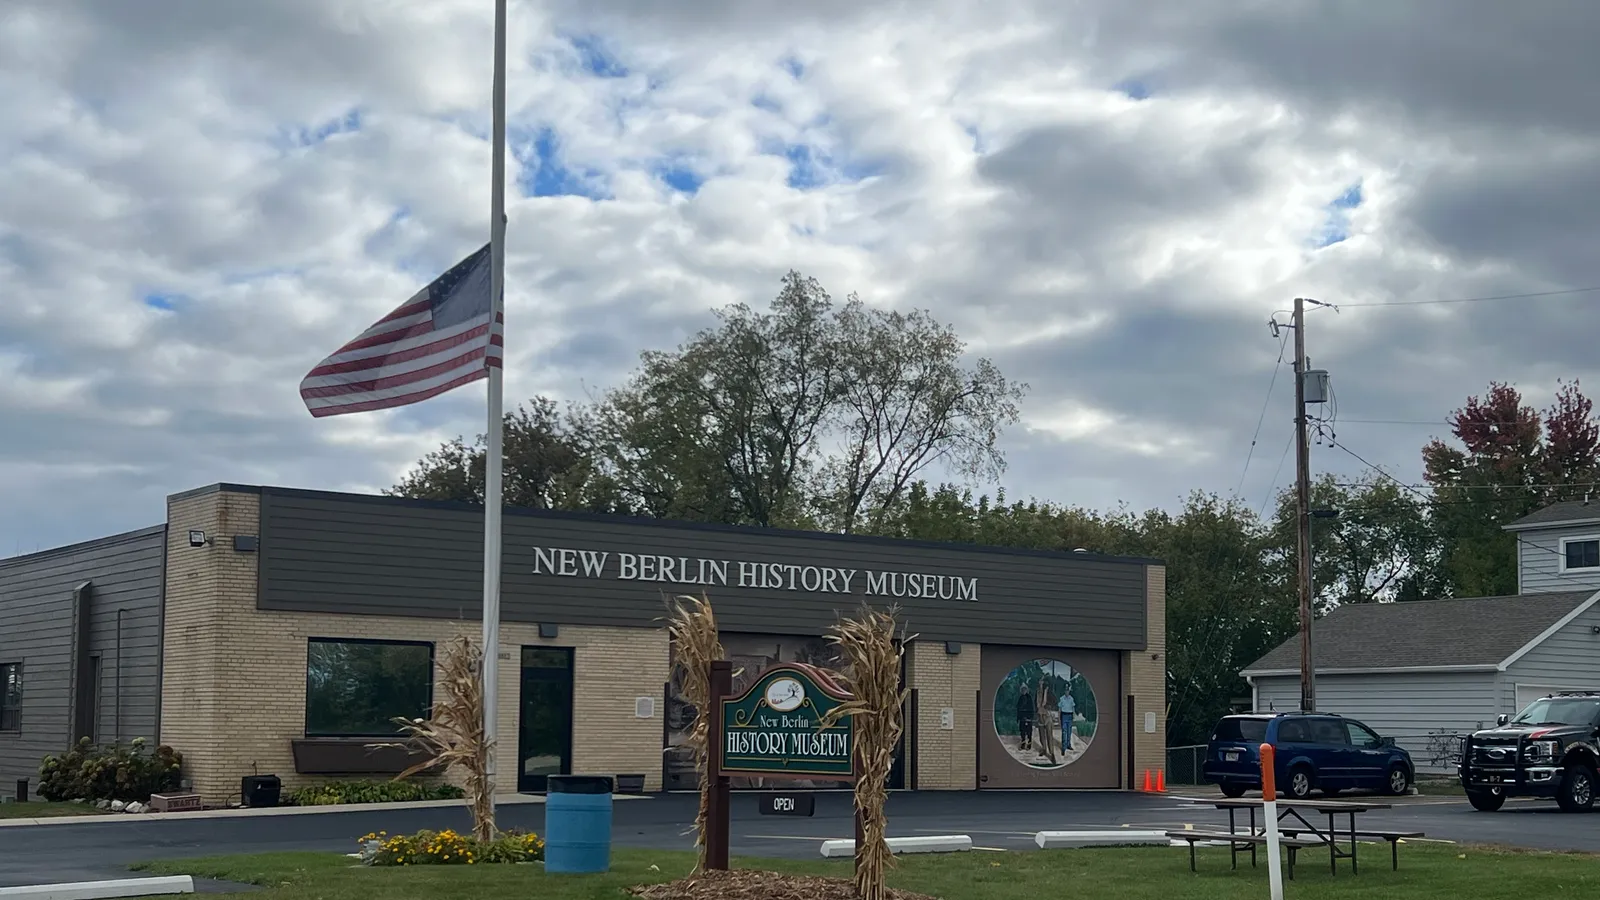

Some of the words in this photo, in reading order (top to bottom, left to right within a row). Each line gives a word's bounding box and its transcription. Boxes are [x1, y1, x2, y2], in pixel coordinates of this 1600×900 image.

[532, 547, 609, 577] NEW
[618, 553, 730, 586] BERLIN
[737, 561, 857, 594] HISTORY
[865, 570, 978, 601] MUSEUM
[760, 715, 779, 728] New
[782, 715, 809, 728] Berlin
[727, 732, 789, 755] HISTORY
[791, 733, 848, 756] MUSEUM
[773, 797, 795, 811] OPEN
